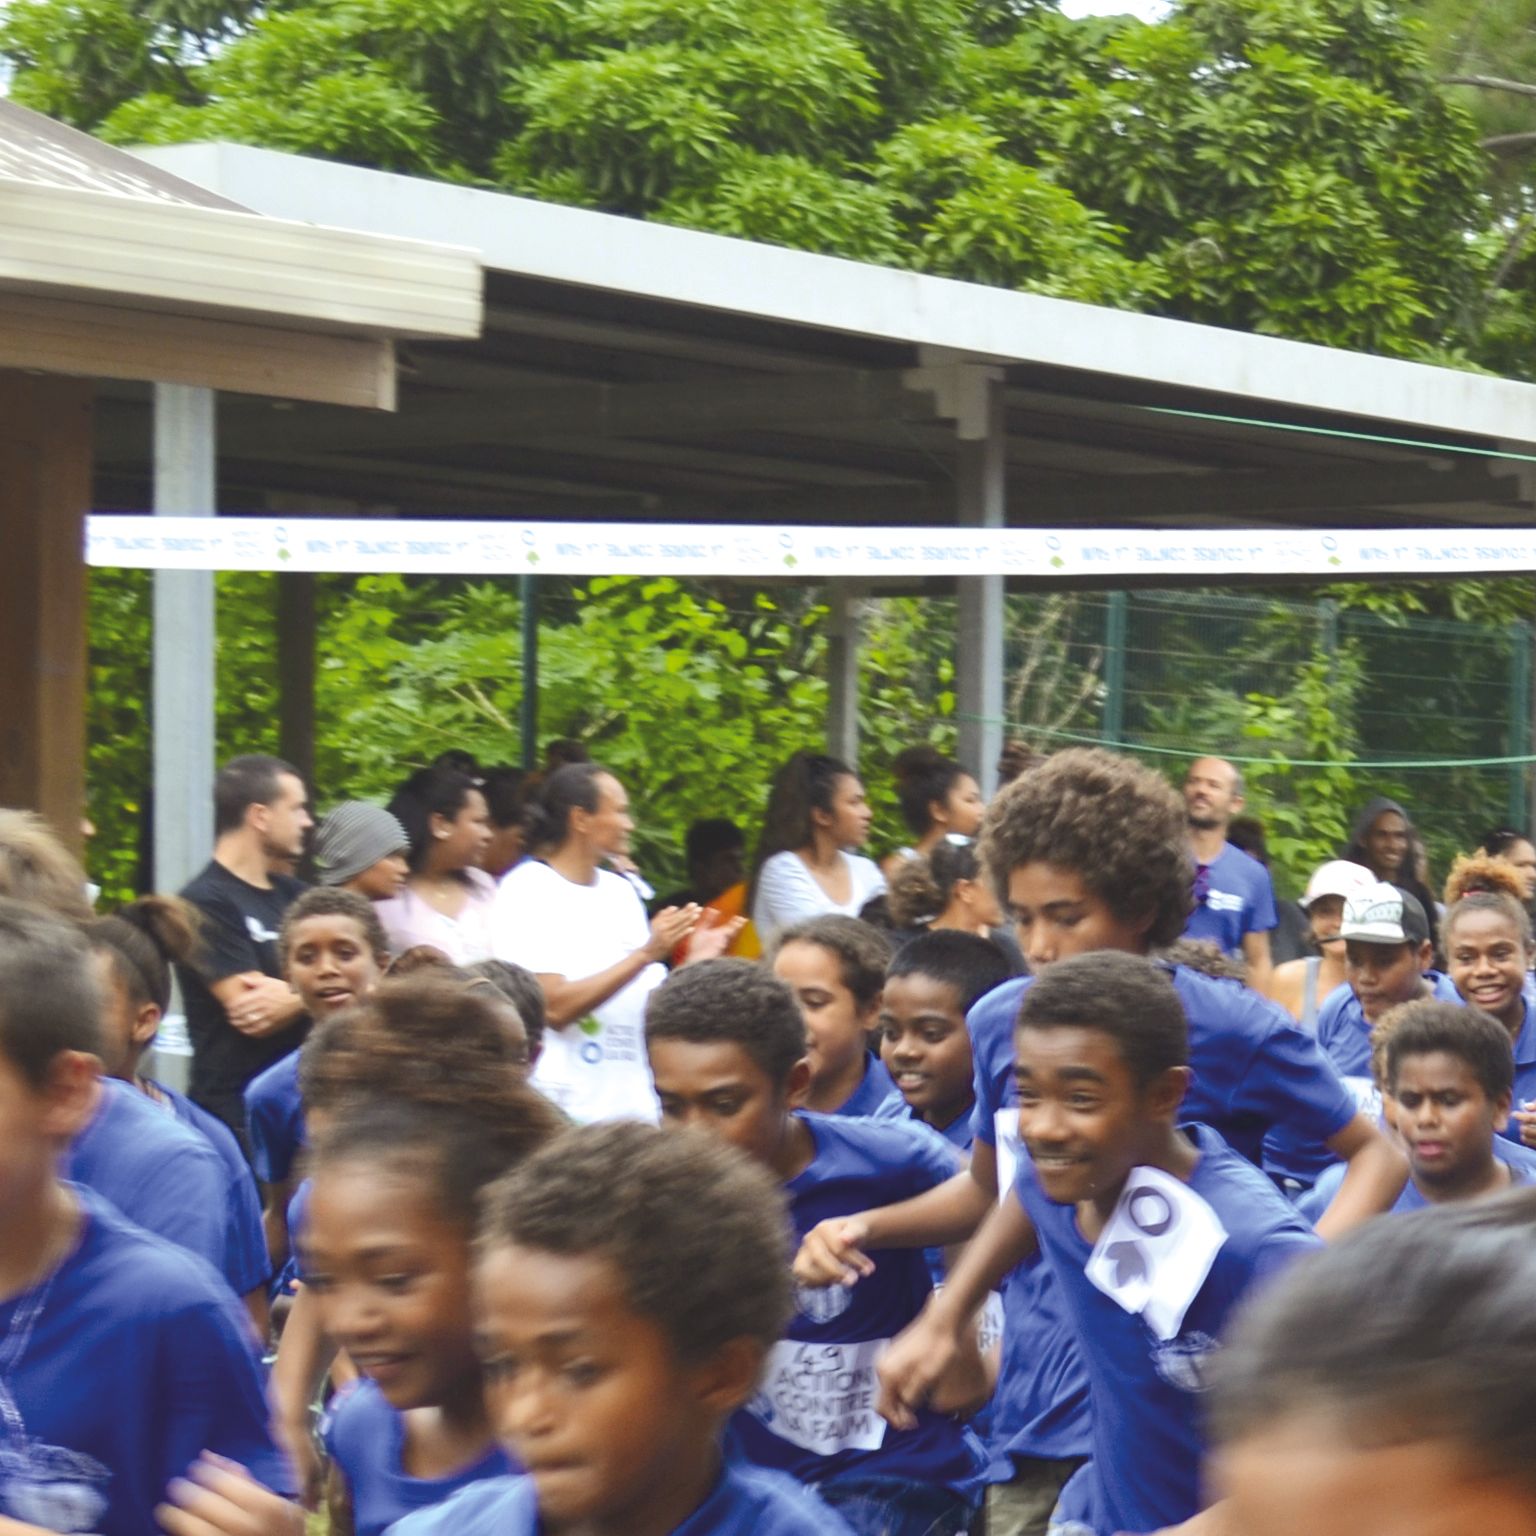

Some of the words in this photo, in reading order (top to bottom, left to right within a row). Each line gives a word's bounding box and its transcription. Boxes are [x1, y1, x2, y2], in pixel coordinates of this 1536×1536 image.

[776, 1366, 873, 1394] ACTION
[775, 1389, 872, 1416] CONTRE
[808, 1412, 872, 1442] FAIM
